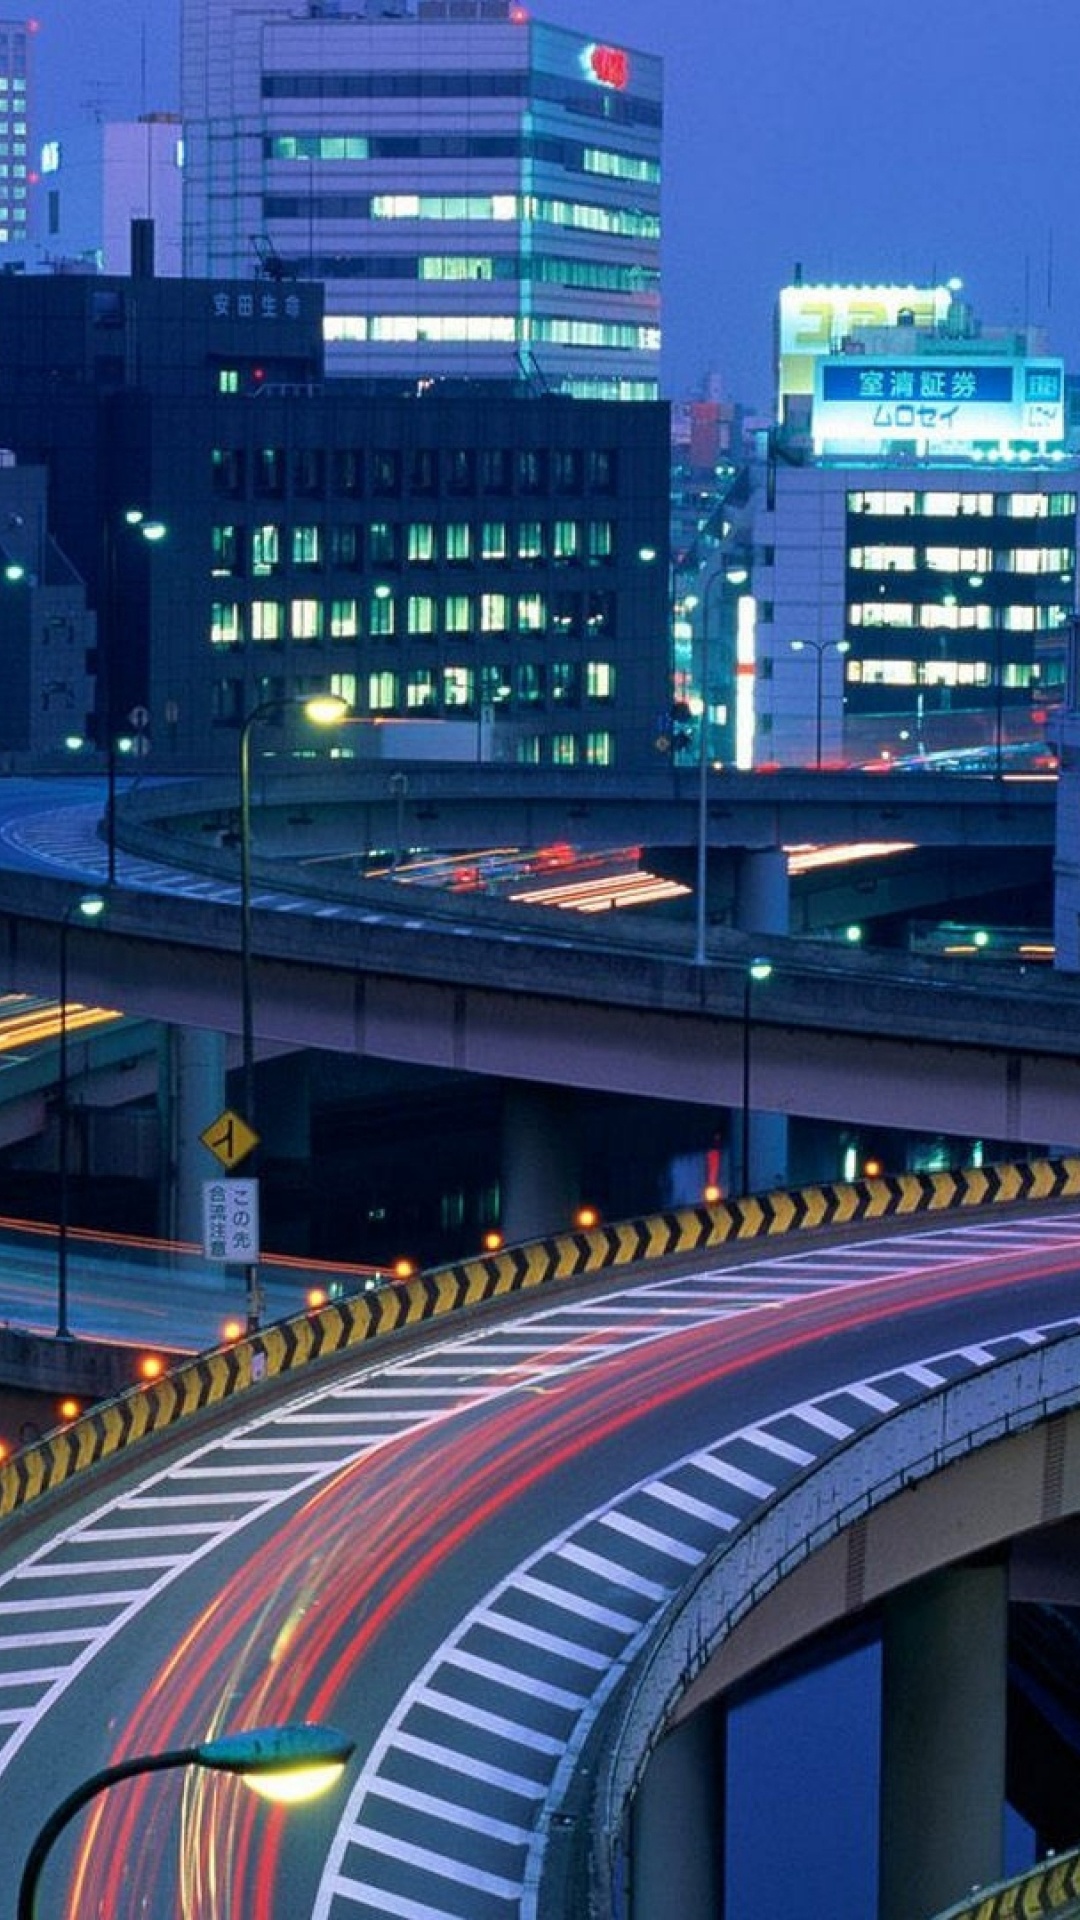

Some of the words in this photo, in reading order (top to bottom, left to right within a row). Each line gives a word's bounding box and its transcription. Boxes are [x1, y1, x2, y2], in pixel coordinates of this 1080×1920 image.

[873, 404, 960, 427] ムロセイ
[208, 1185, 227, 1257] 合流注意
[233, 1190, 251, 1249] この先
